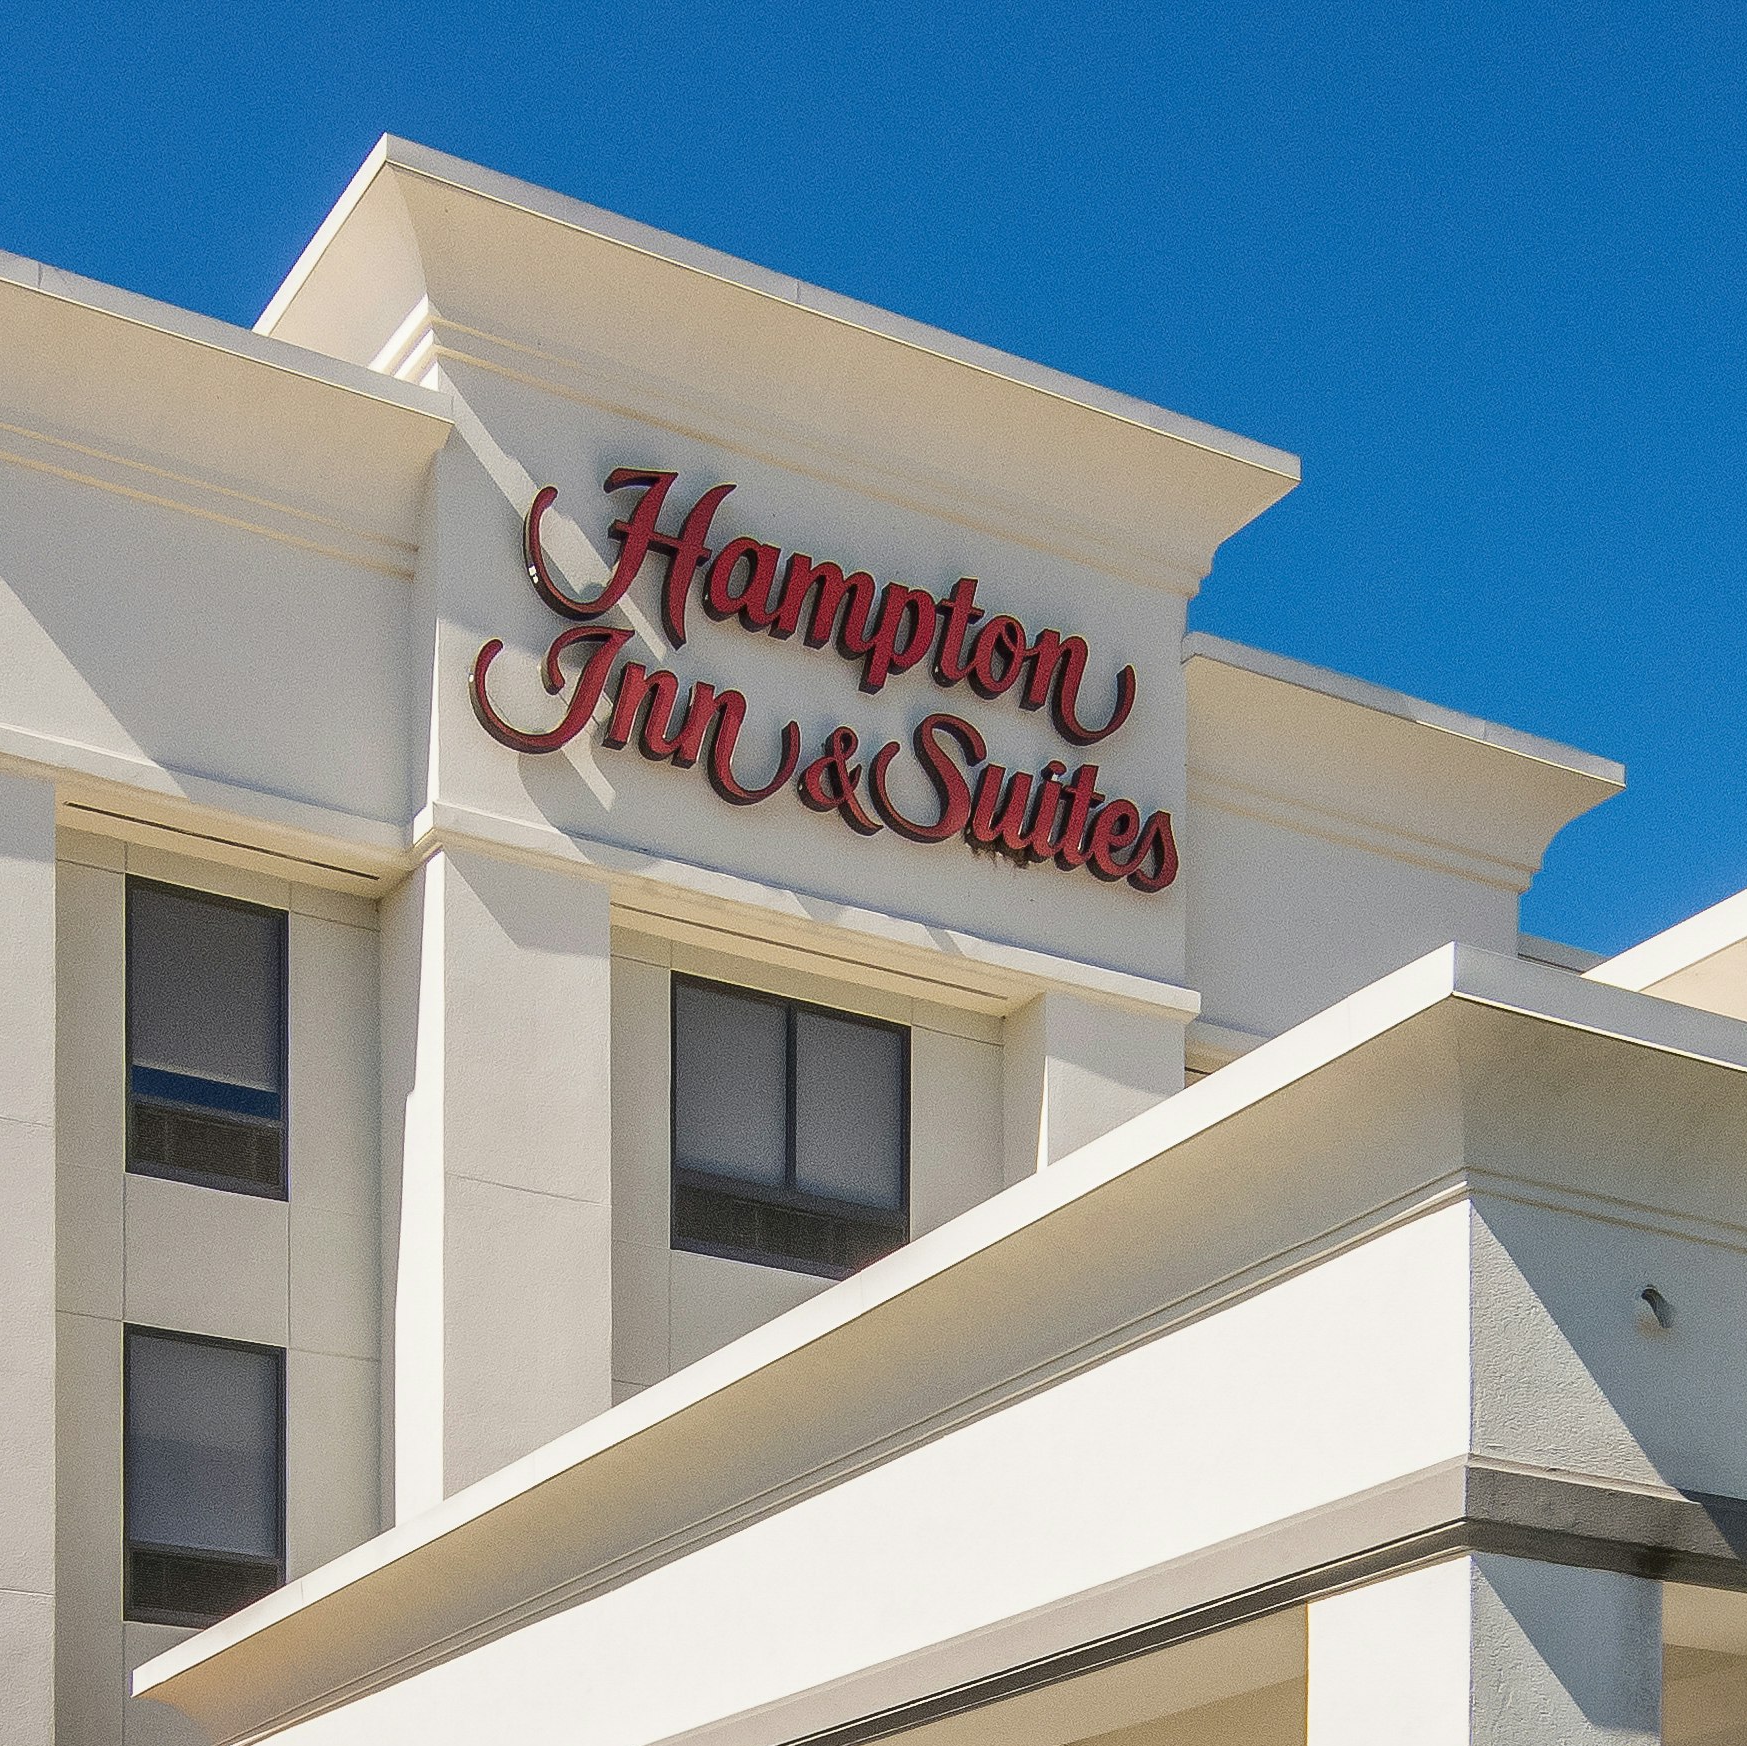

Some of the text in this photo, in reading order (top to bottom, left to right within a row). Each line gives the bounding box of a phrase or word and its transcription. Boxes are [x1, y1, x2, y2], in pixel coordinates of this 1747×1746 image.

[524, 468, 1137, 746] Hampton
[470, 627, 1180, 893] Inn & Suites
